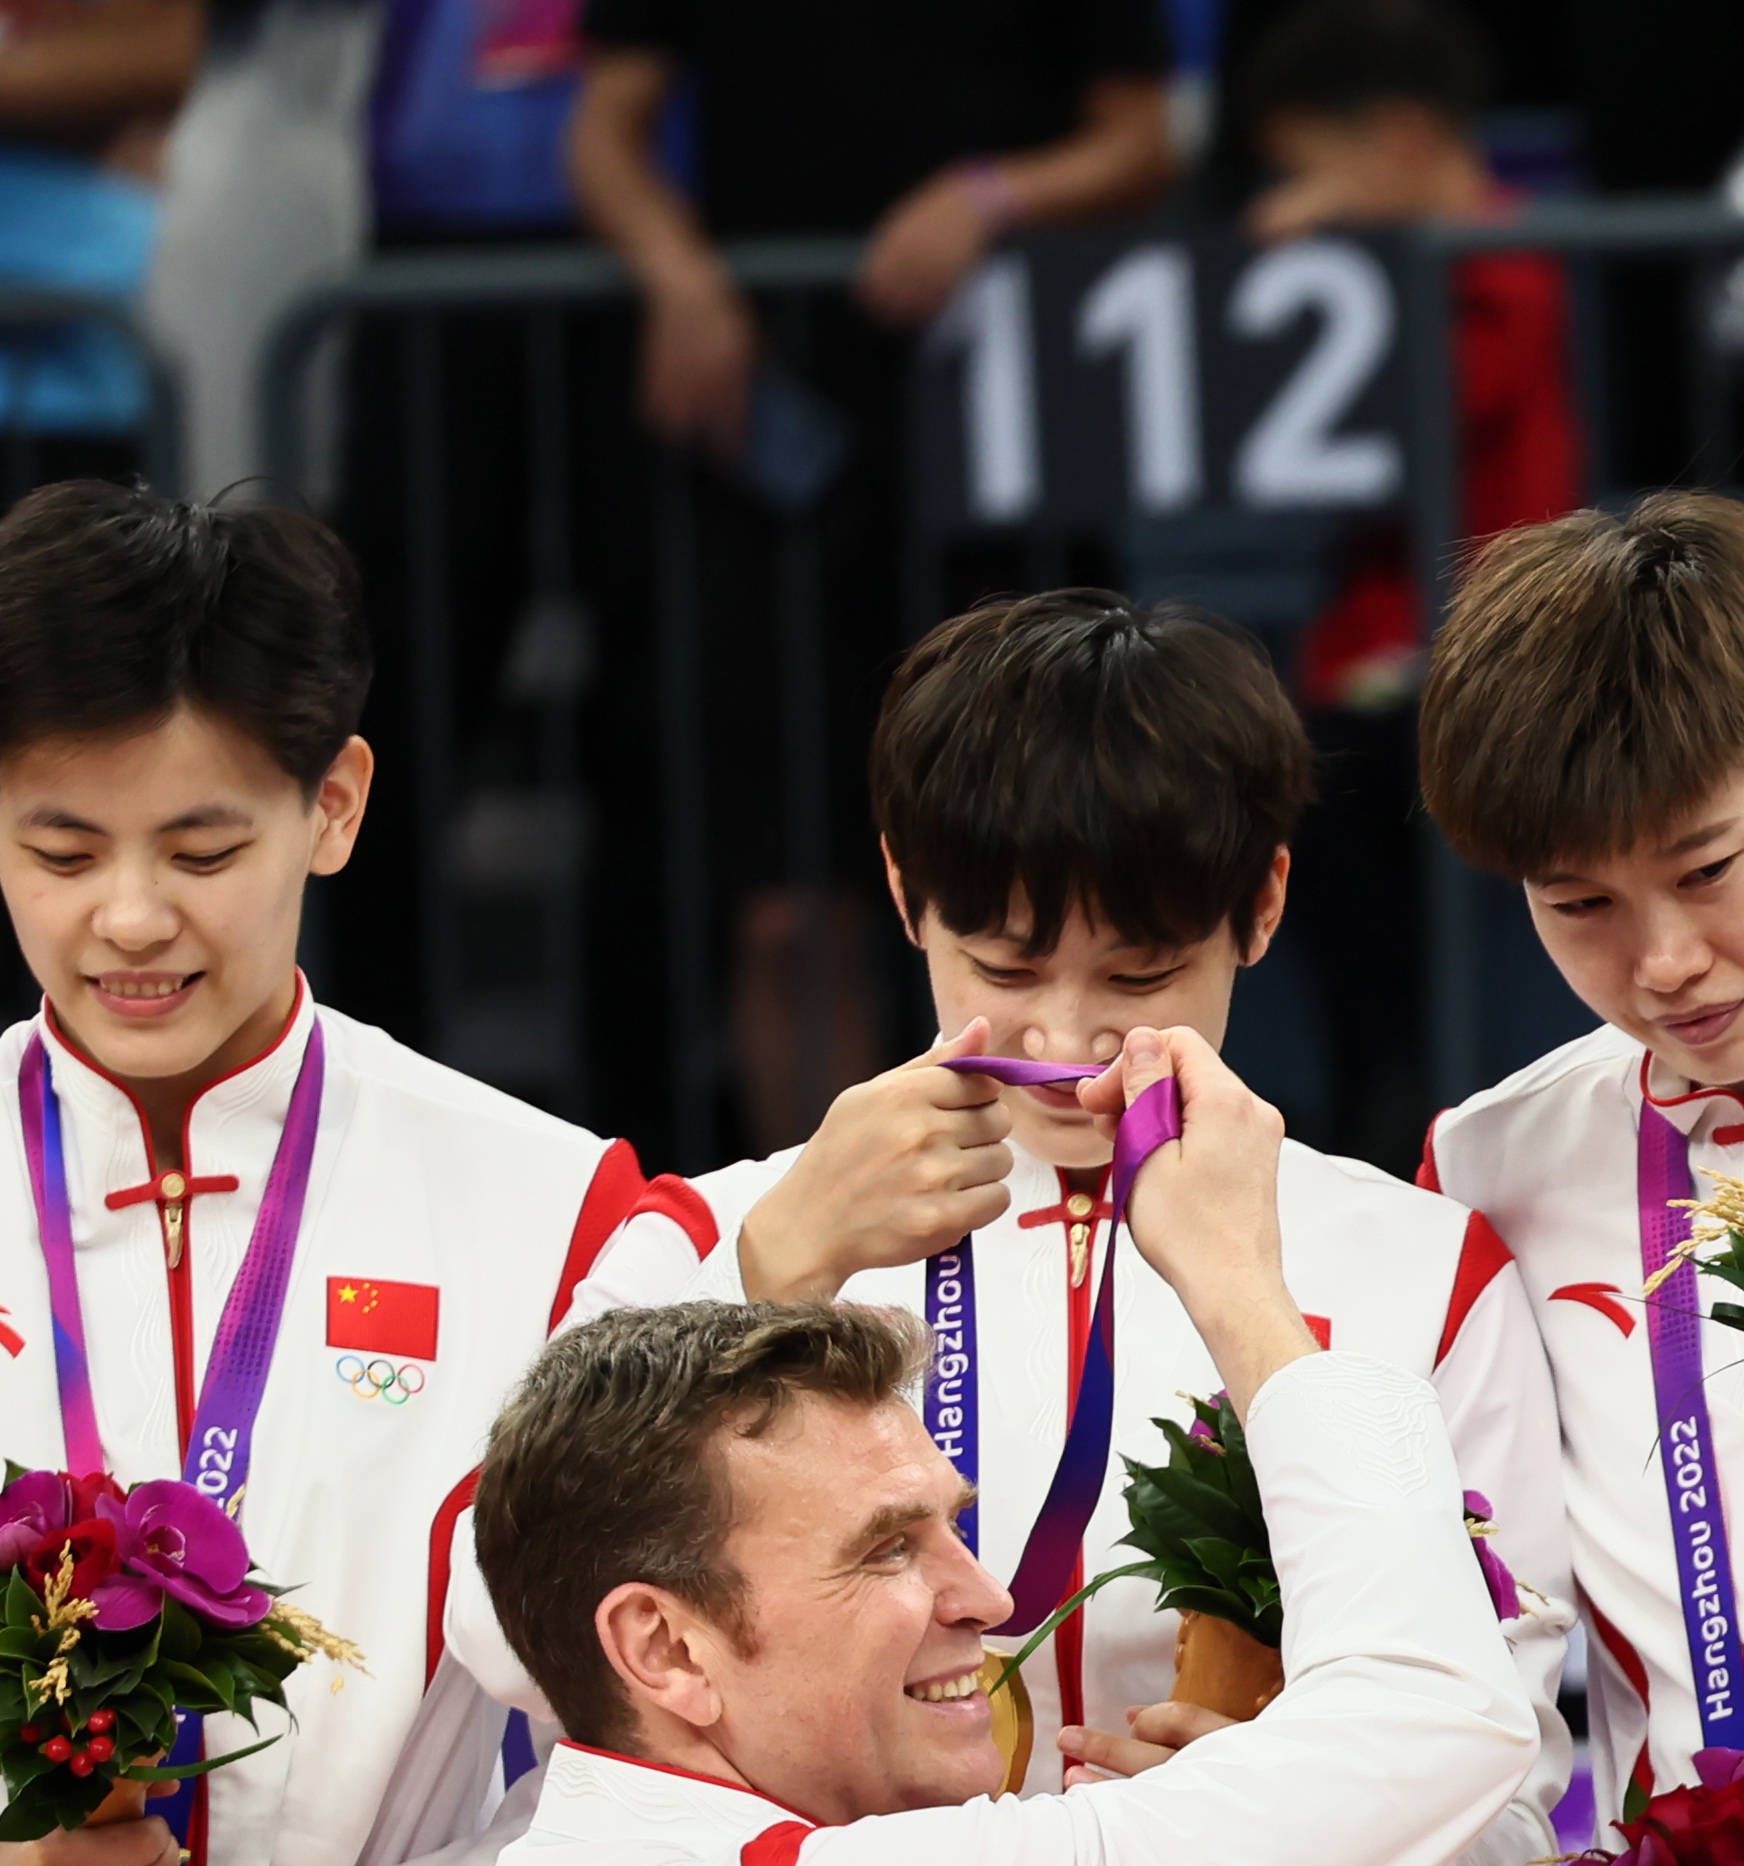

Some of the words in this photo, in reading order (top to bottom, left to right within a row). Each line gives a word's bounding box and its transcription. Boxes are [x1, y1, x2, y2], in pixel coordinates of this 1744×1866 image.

[926, 238, 1402, 522] 112
[934, 1252, 969, 1459] Hangzhou
[196, 1425, 238, 1509] 022
[1670, 1416, 1708, 1513] 2022
[1689, 1520, 1733, 1722] Hangzhou
